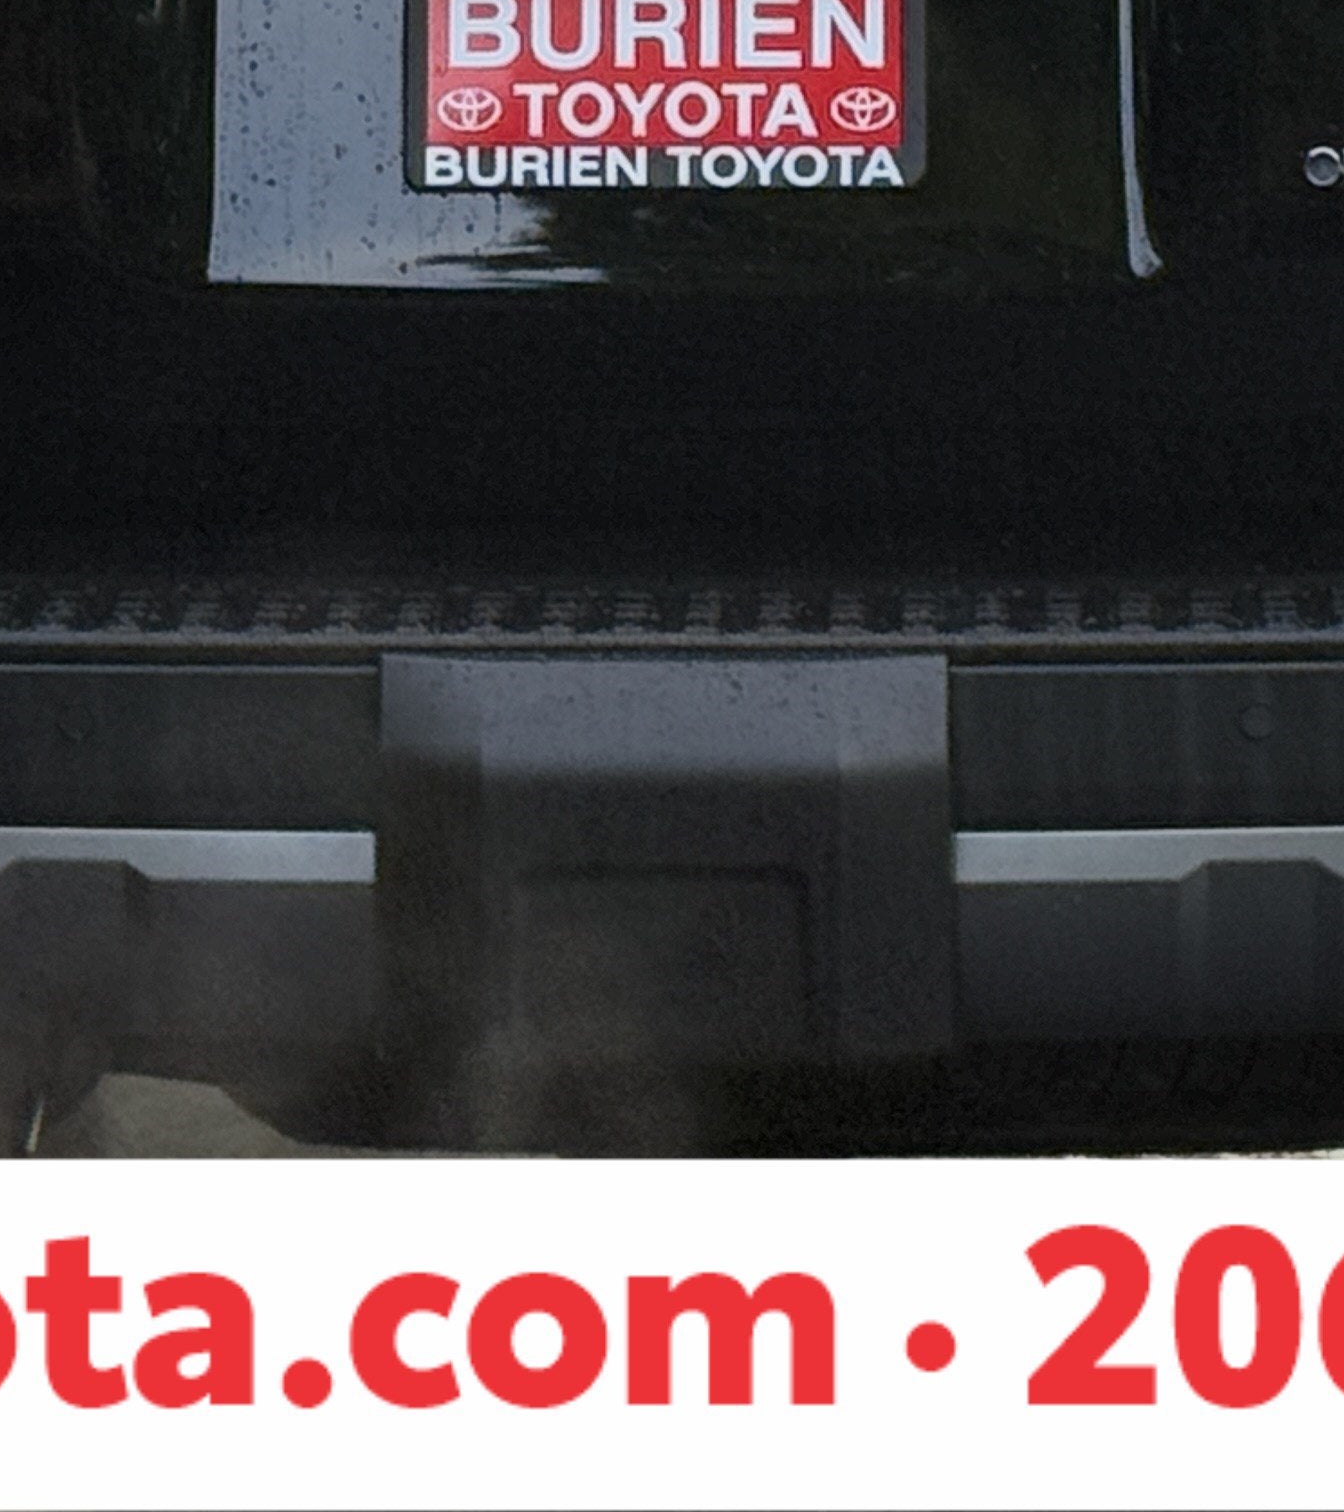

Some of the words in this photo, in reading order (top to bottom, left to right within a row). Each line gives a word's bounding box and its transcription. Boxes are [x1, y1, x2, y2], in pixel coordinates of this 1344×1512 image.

[511, 80, 819, 139] TOYOTA
[424, 145, 649, 188] BURIEN
[664, 145, 905, 188] TOYOTA
